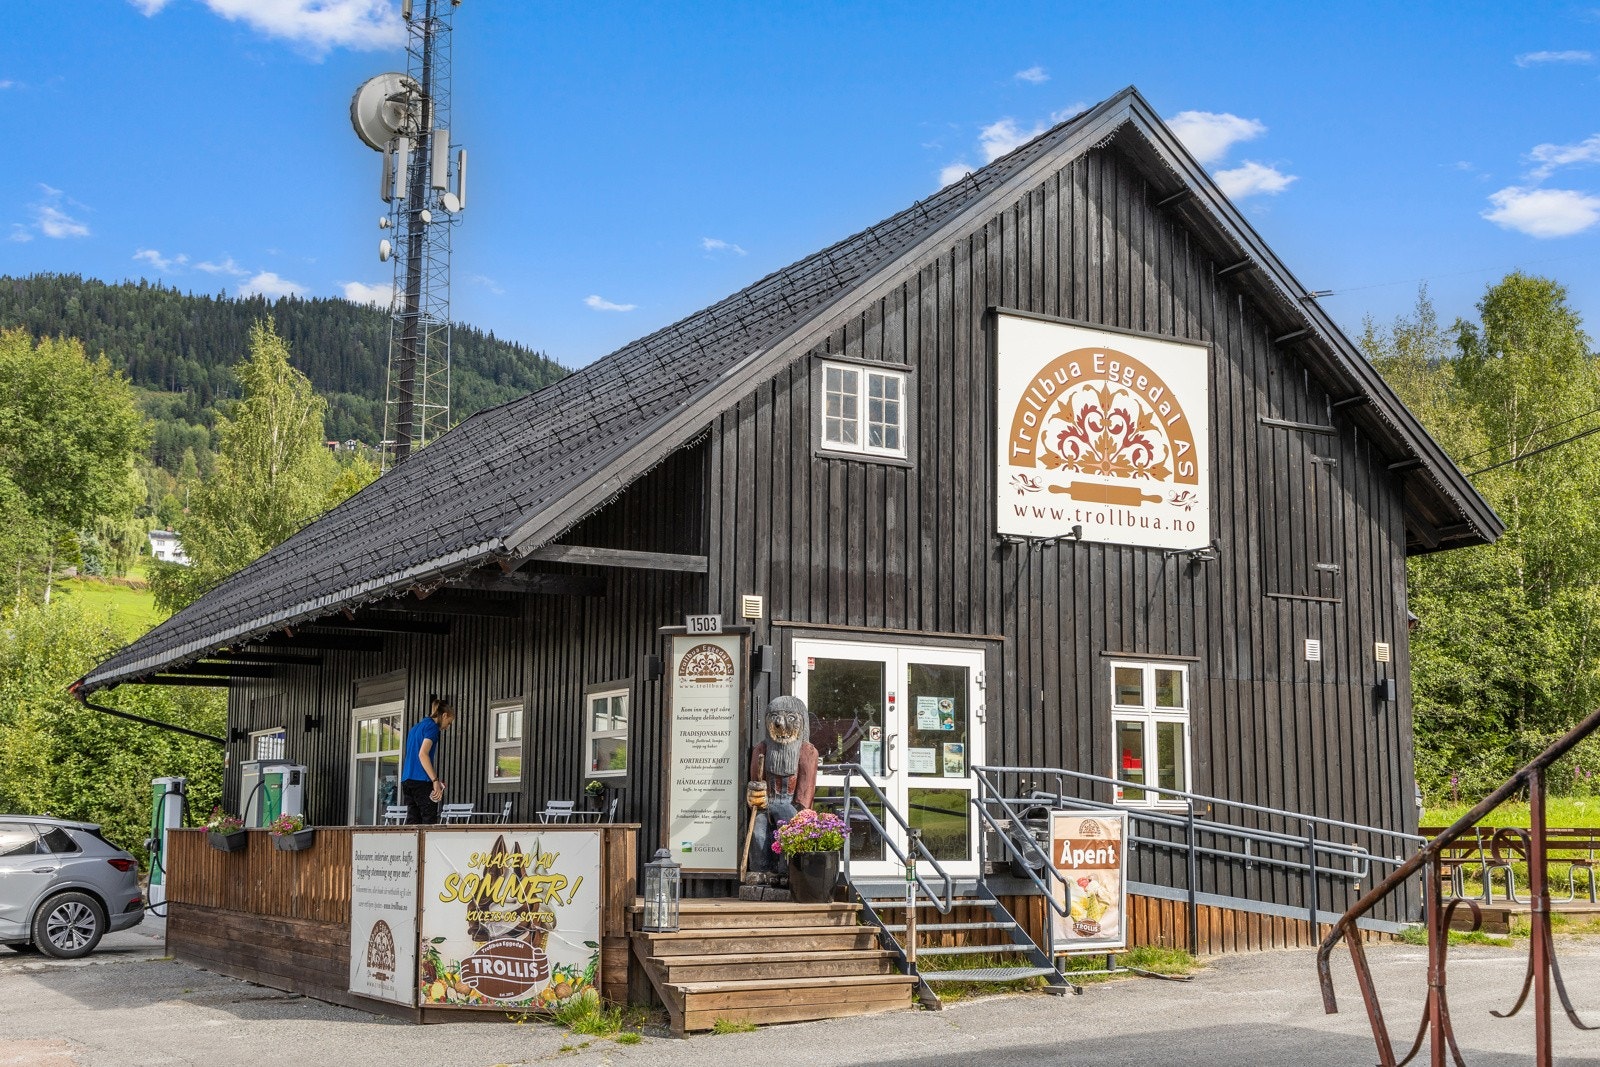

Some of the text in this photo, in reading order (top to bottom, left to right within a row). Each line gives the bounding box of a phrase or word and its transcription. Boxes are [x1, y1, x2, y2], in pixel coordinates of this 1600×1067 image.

[1012, 352, 1195, 478] Trollbua Eggedal AS
[1013, 503, 1196, 533] www.trollbua.no
[691, 617, 717, 632] 1503
[679, 645, 734, 674] Trollbua Eggedal AS
[709, 706, 718, 714] nyt
[711, 757, 730, 765] KJØTT
[676, 777, 711, 786] HÅNDLAGET
[467, 851, 560, 869] SMAKEN AV
[1060, 839, 1116, 869] Åpent
[438, 872, 584, 907] SOMMER!
[465, 911, 555, 924] KULEIS OG SOFTIS
[1075, 922, 1099, 932] TROLLIS
[481, 940, 525, 954] Trollbua Eggedal
[471, 958, 539, 978] TROLLIS
